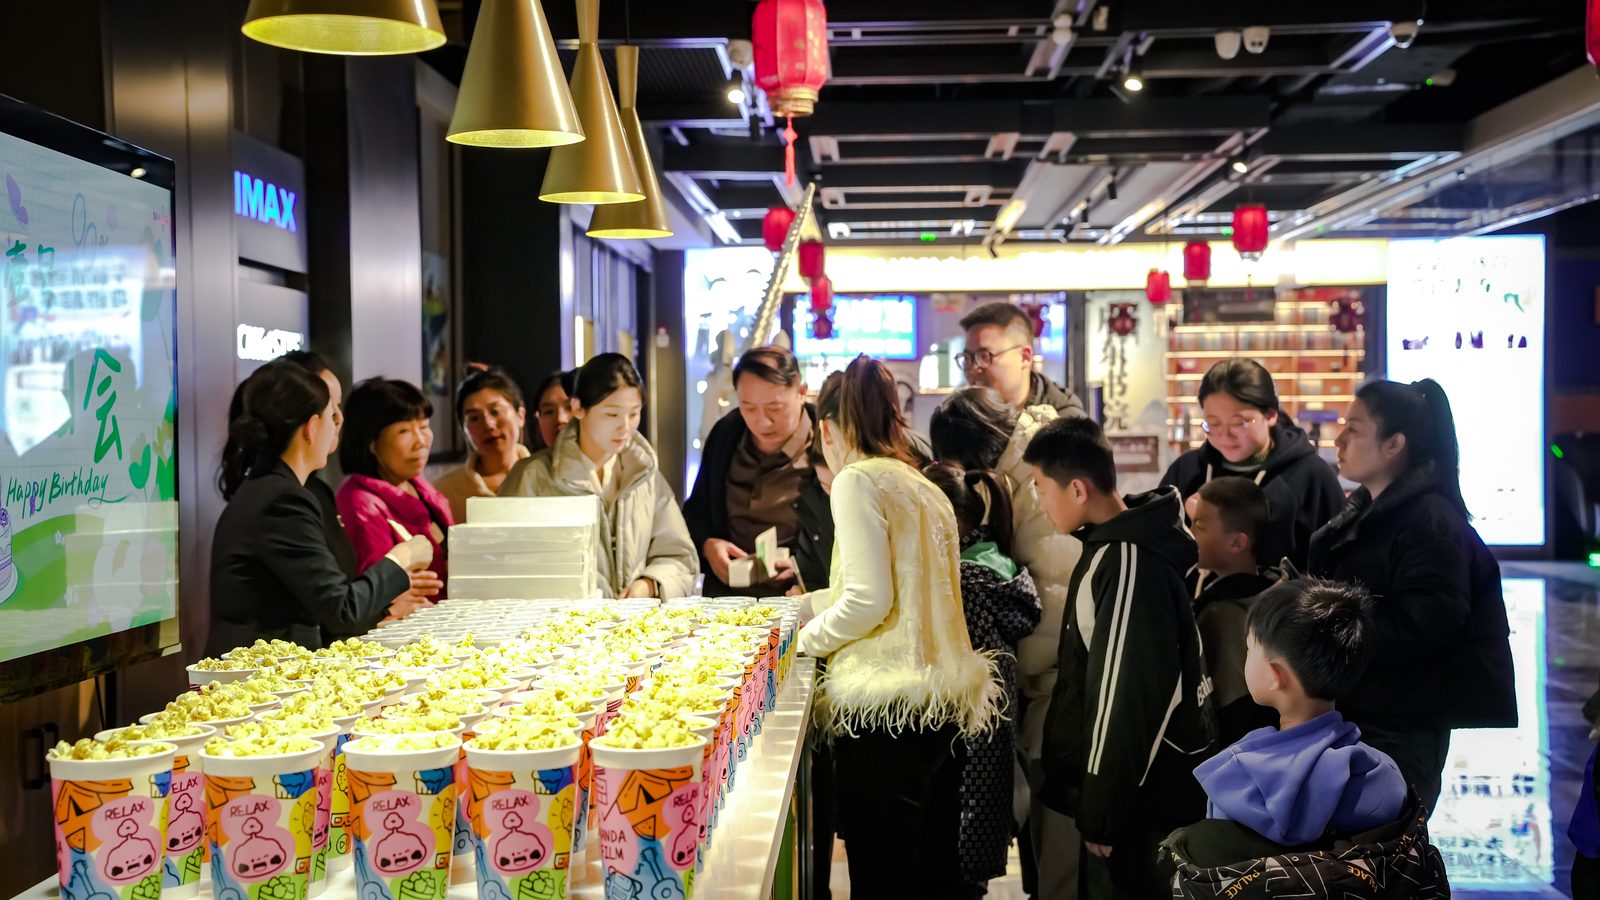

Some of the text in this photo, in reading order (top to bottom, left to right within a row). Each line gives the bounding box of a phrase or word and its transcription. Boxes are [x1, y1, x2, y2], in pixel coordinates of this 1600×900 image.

[234, 170, 297, 232] IMAX
[83, 348, 122, 464] 会
[6, 467, 109, 519] Happy Birthday
[171, 776, 199, 795] ELAX
[372, 795, 411, 812] RELAX
[492, 795, 530, 811] RELAX
[673, 789, 698, 808] RELA
[105, 801, 145, 820] RELAX
[230, 800, 270, 818] RELAX
[600, 829, 627, 843] ANDA
[1224, 869, 1261, 900] PALACE
